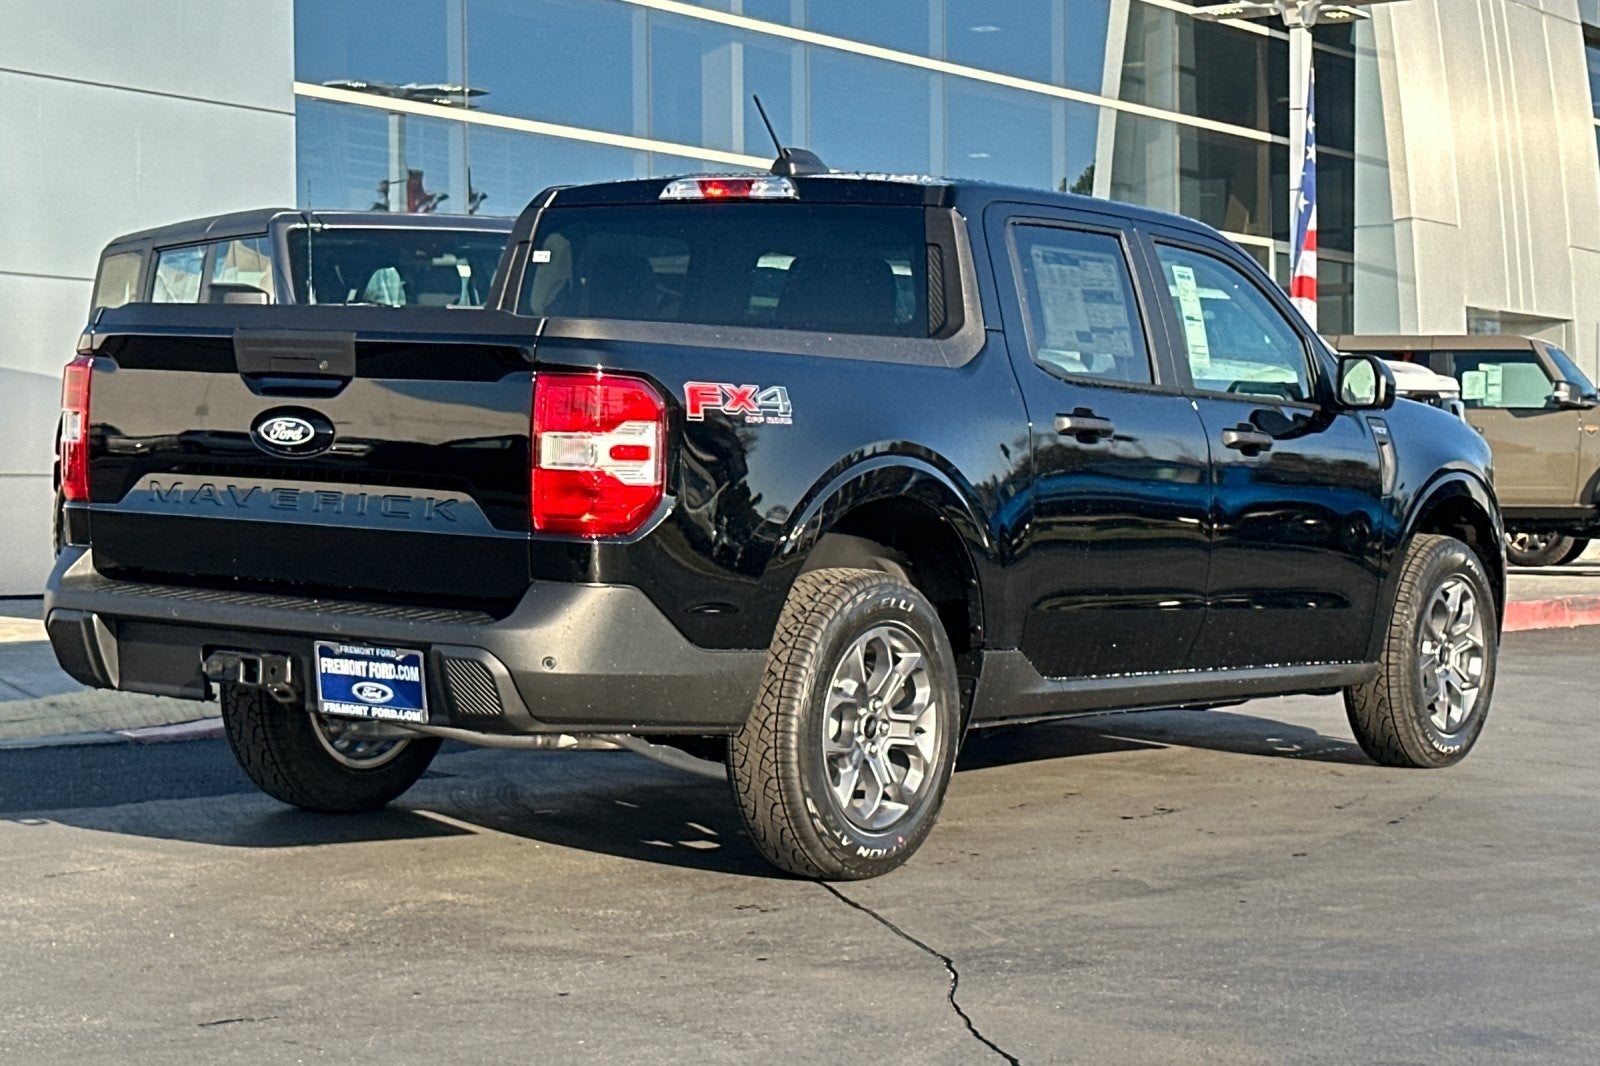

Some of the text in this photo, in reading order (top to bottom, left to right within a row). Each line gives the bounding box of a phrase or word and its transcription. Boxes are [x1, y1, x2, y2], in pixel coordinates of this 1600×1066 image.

[683, 381, 793, 422] FX4
[270, 420, 305, 442] Ford
[148, 480, 459, 522] MAVERICK
[340, 645, 396, 657] FREMONT FORD
[320, 657, 419, 681] FREMONT FORD.COM
